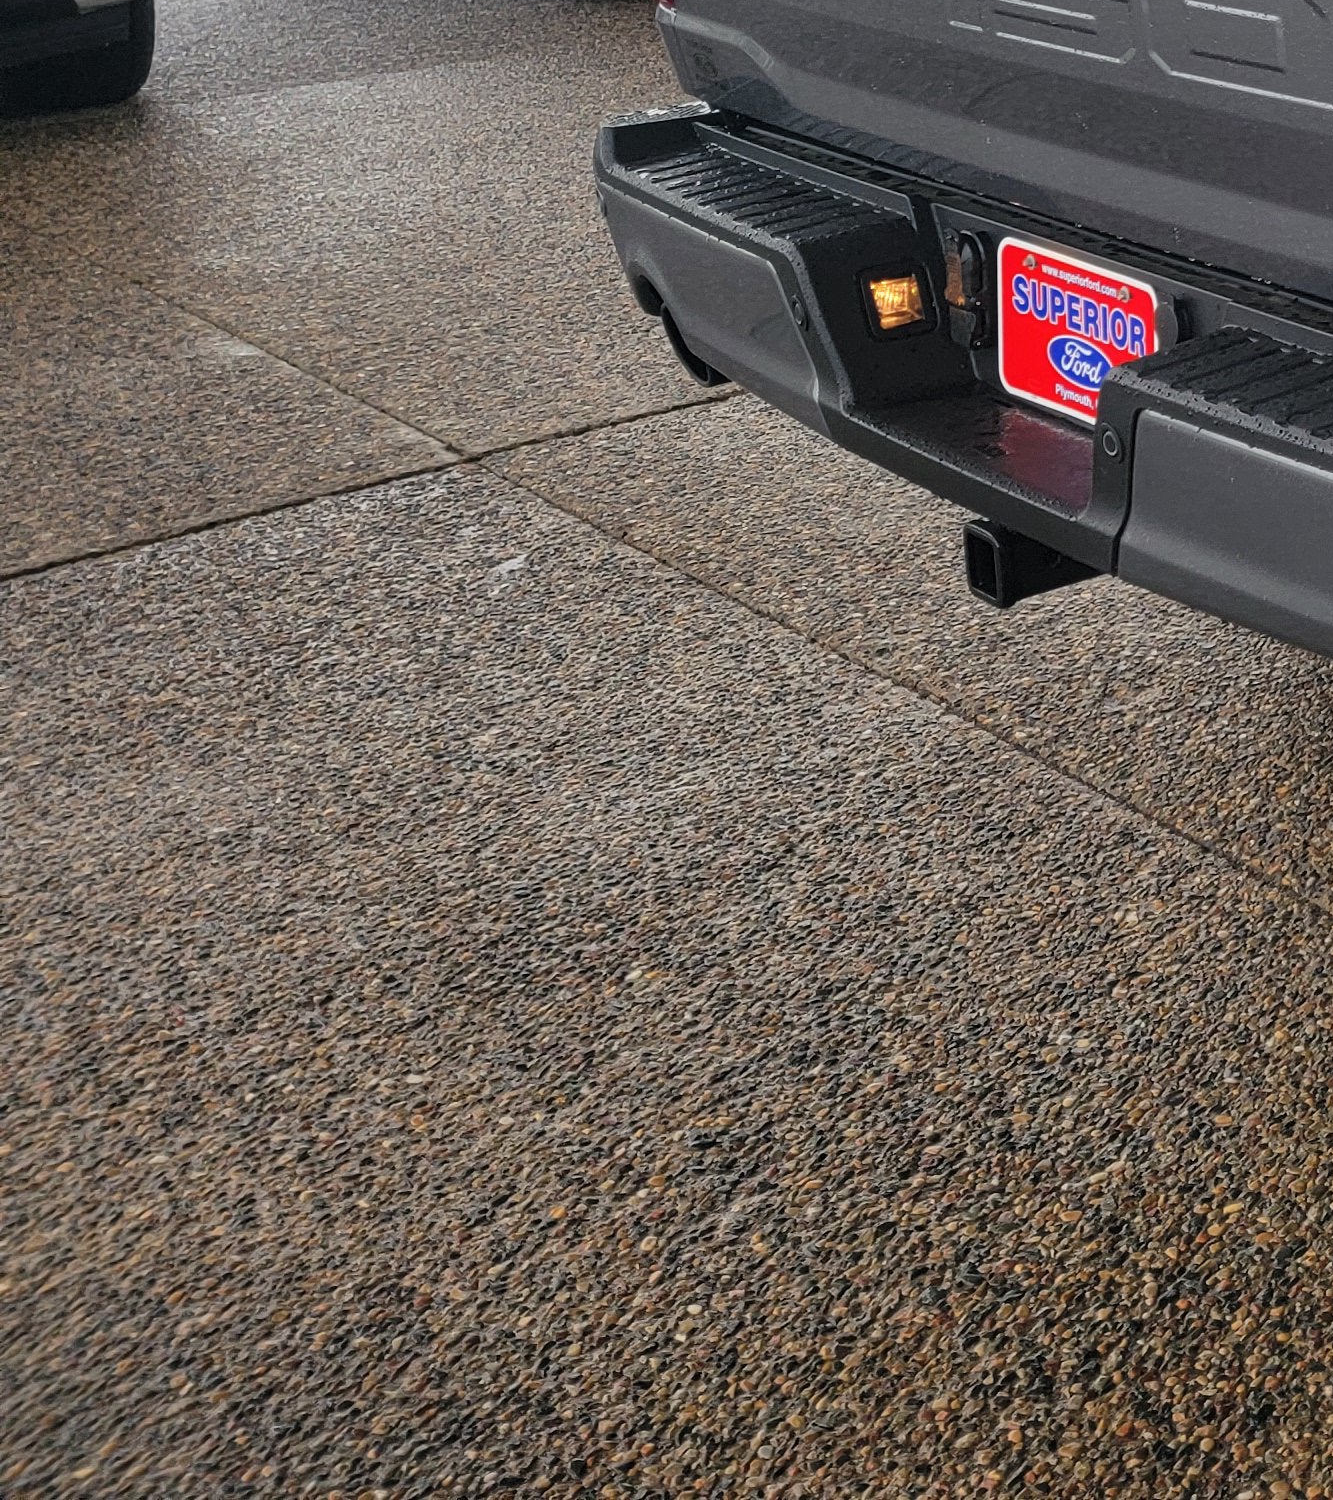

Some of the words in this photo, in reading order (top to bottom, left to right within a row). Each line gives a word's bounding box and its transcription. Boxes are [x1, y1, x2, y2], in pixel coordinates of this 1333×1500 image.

[1041, 264, 1118, 298] www.superiorford.com
[1012, 274, 1146, 357] SUPERIOR
[1060, 341, 1102, 384] Ford
